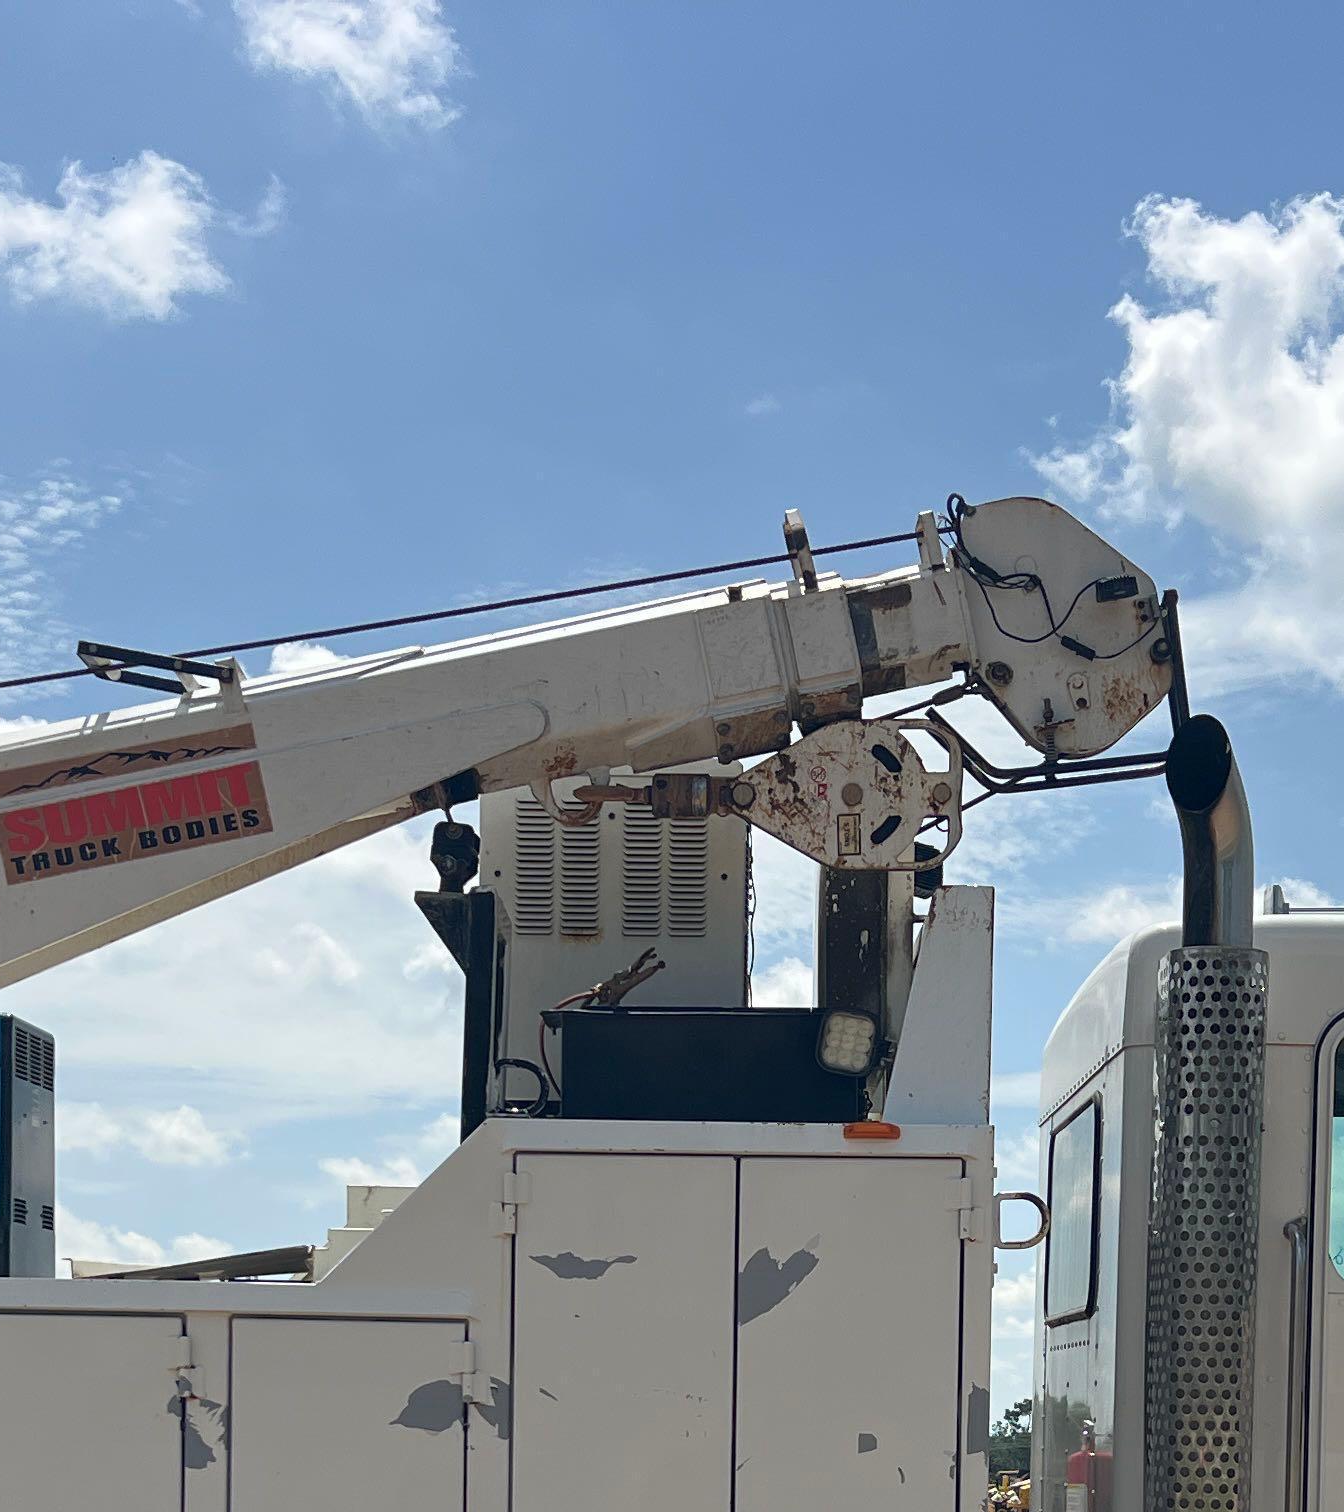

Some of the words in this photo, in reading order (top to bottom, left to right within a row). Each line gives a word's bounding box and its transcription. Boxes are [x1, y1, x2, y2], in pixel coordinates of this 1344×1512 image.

[6, 761, 254, 854] SUMMIT
[11, 837, 122, 875] TRUCK
[138, 809, 260, 849] BODIES
